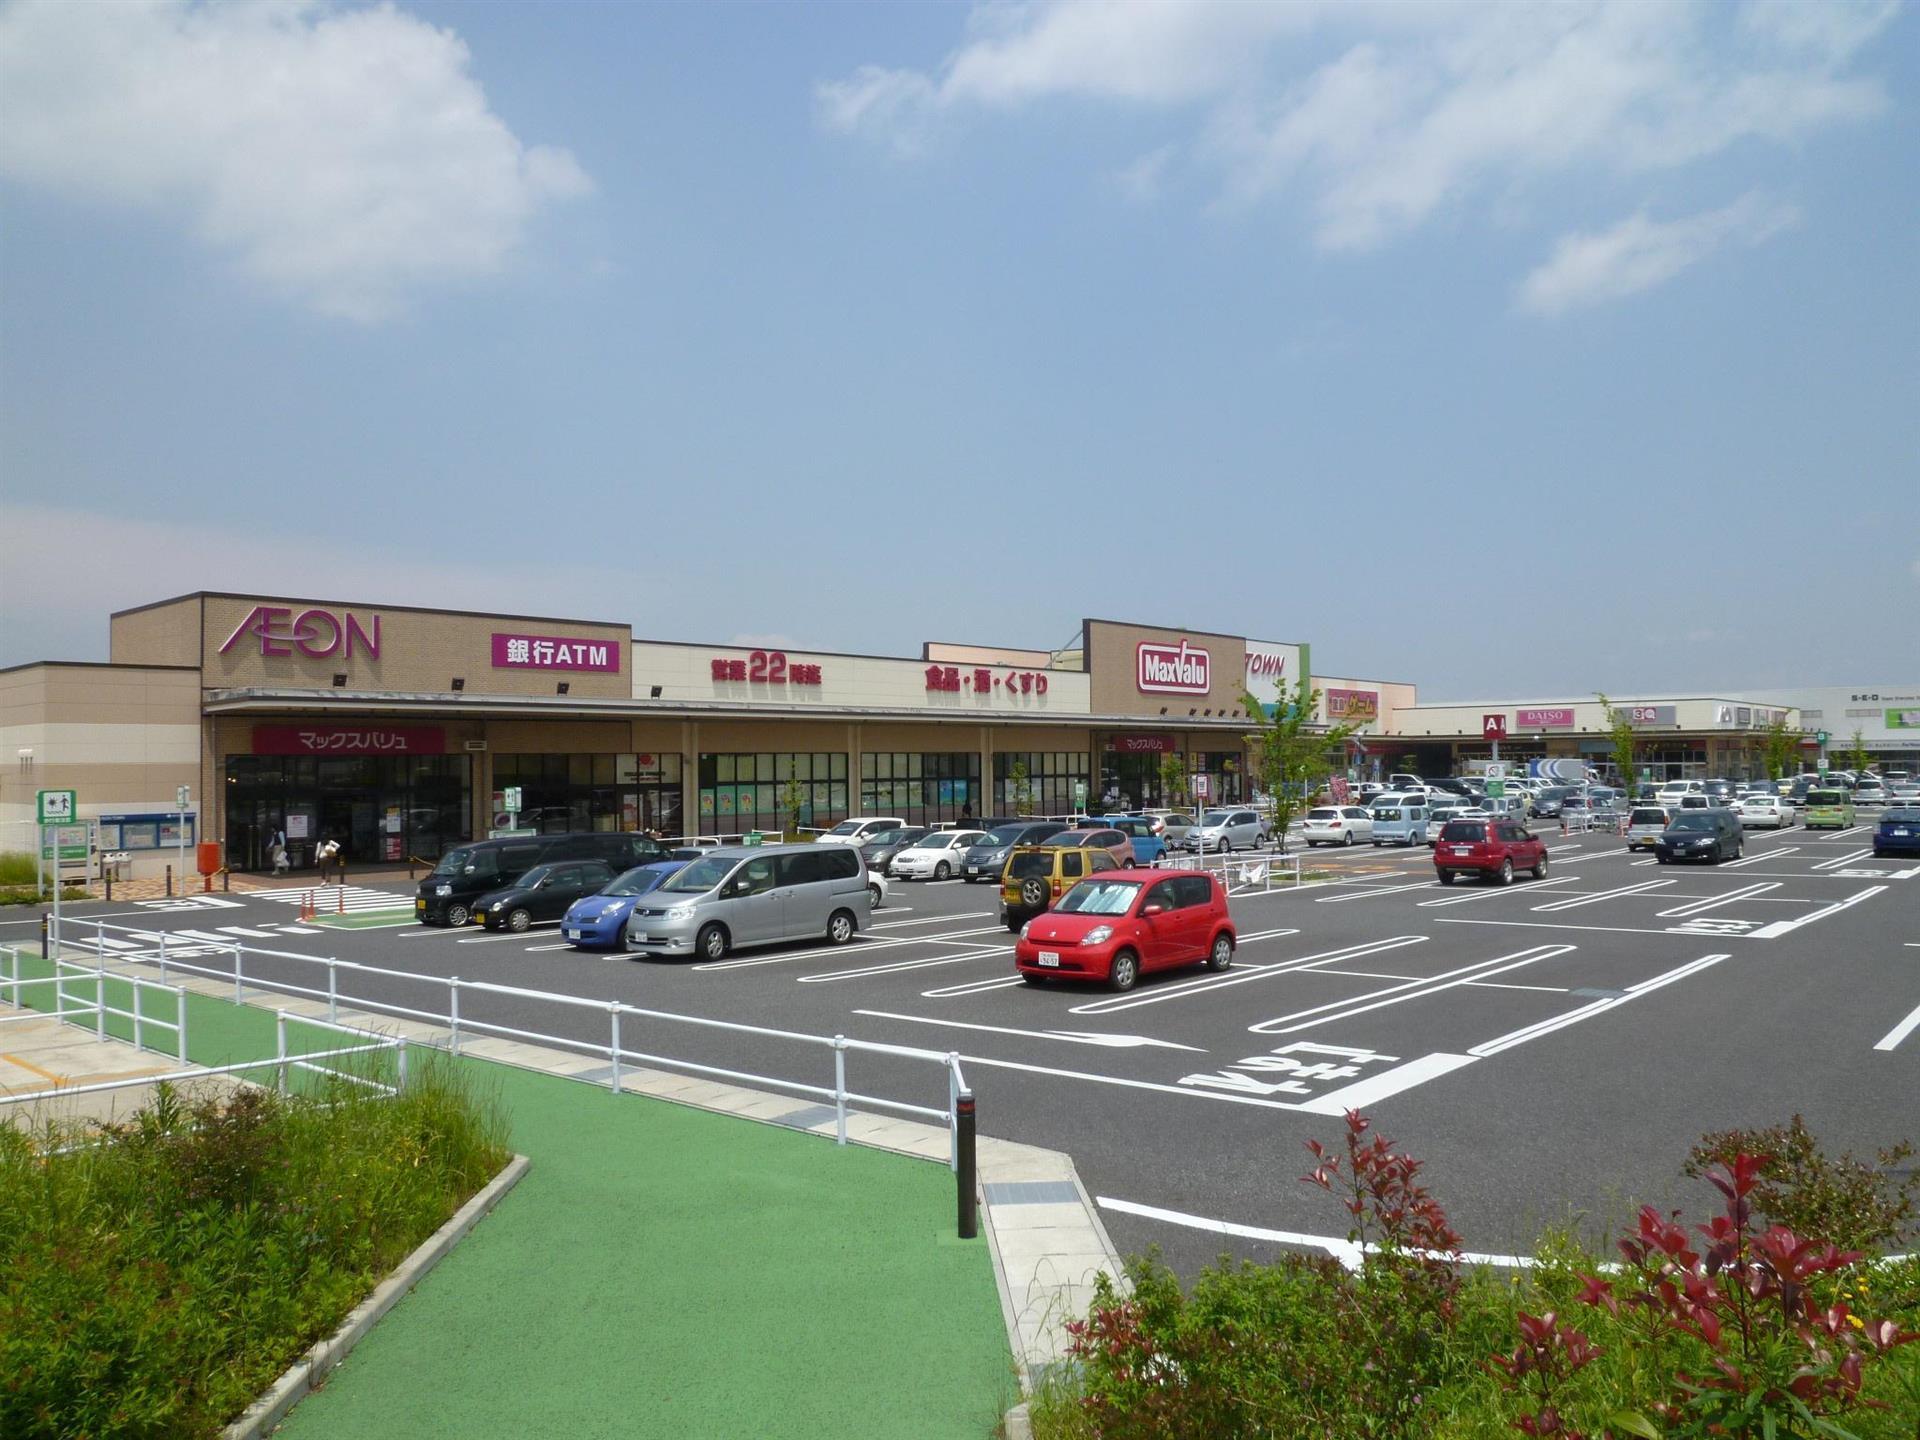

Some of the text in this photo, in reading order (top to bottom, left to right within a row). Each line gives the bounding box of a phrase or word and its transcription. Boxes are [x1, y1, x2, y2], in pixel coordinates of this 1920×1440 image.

[507, 639, 607, 665] 銀行ATM
[1145, 641, 1205, 685] MaxValu
[1246, 653, 1285, 676] TOWN
[1486, 717, 1498, 730] A
[1528, 711, 1563, 720] DAISO
[299, 732, 408, 749] マックスバリュ
[1127, 739, 1164, 750] マックスバリュ
